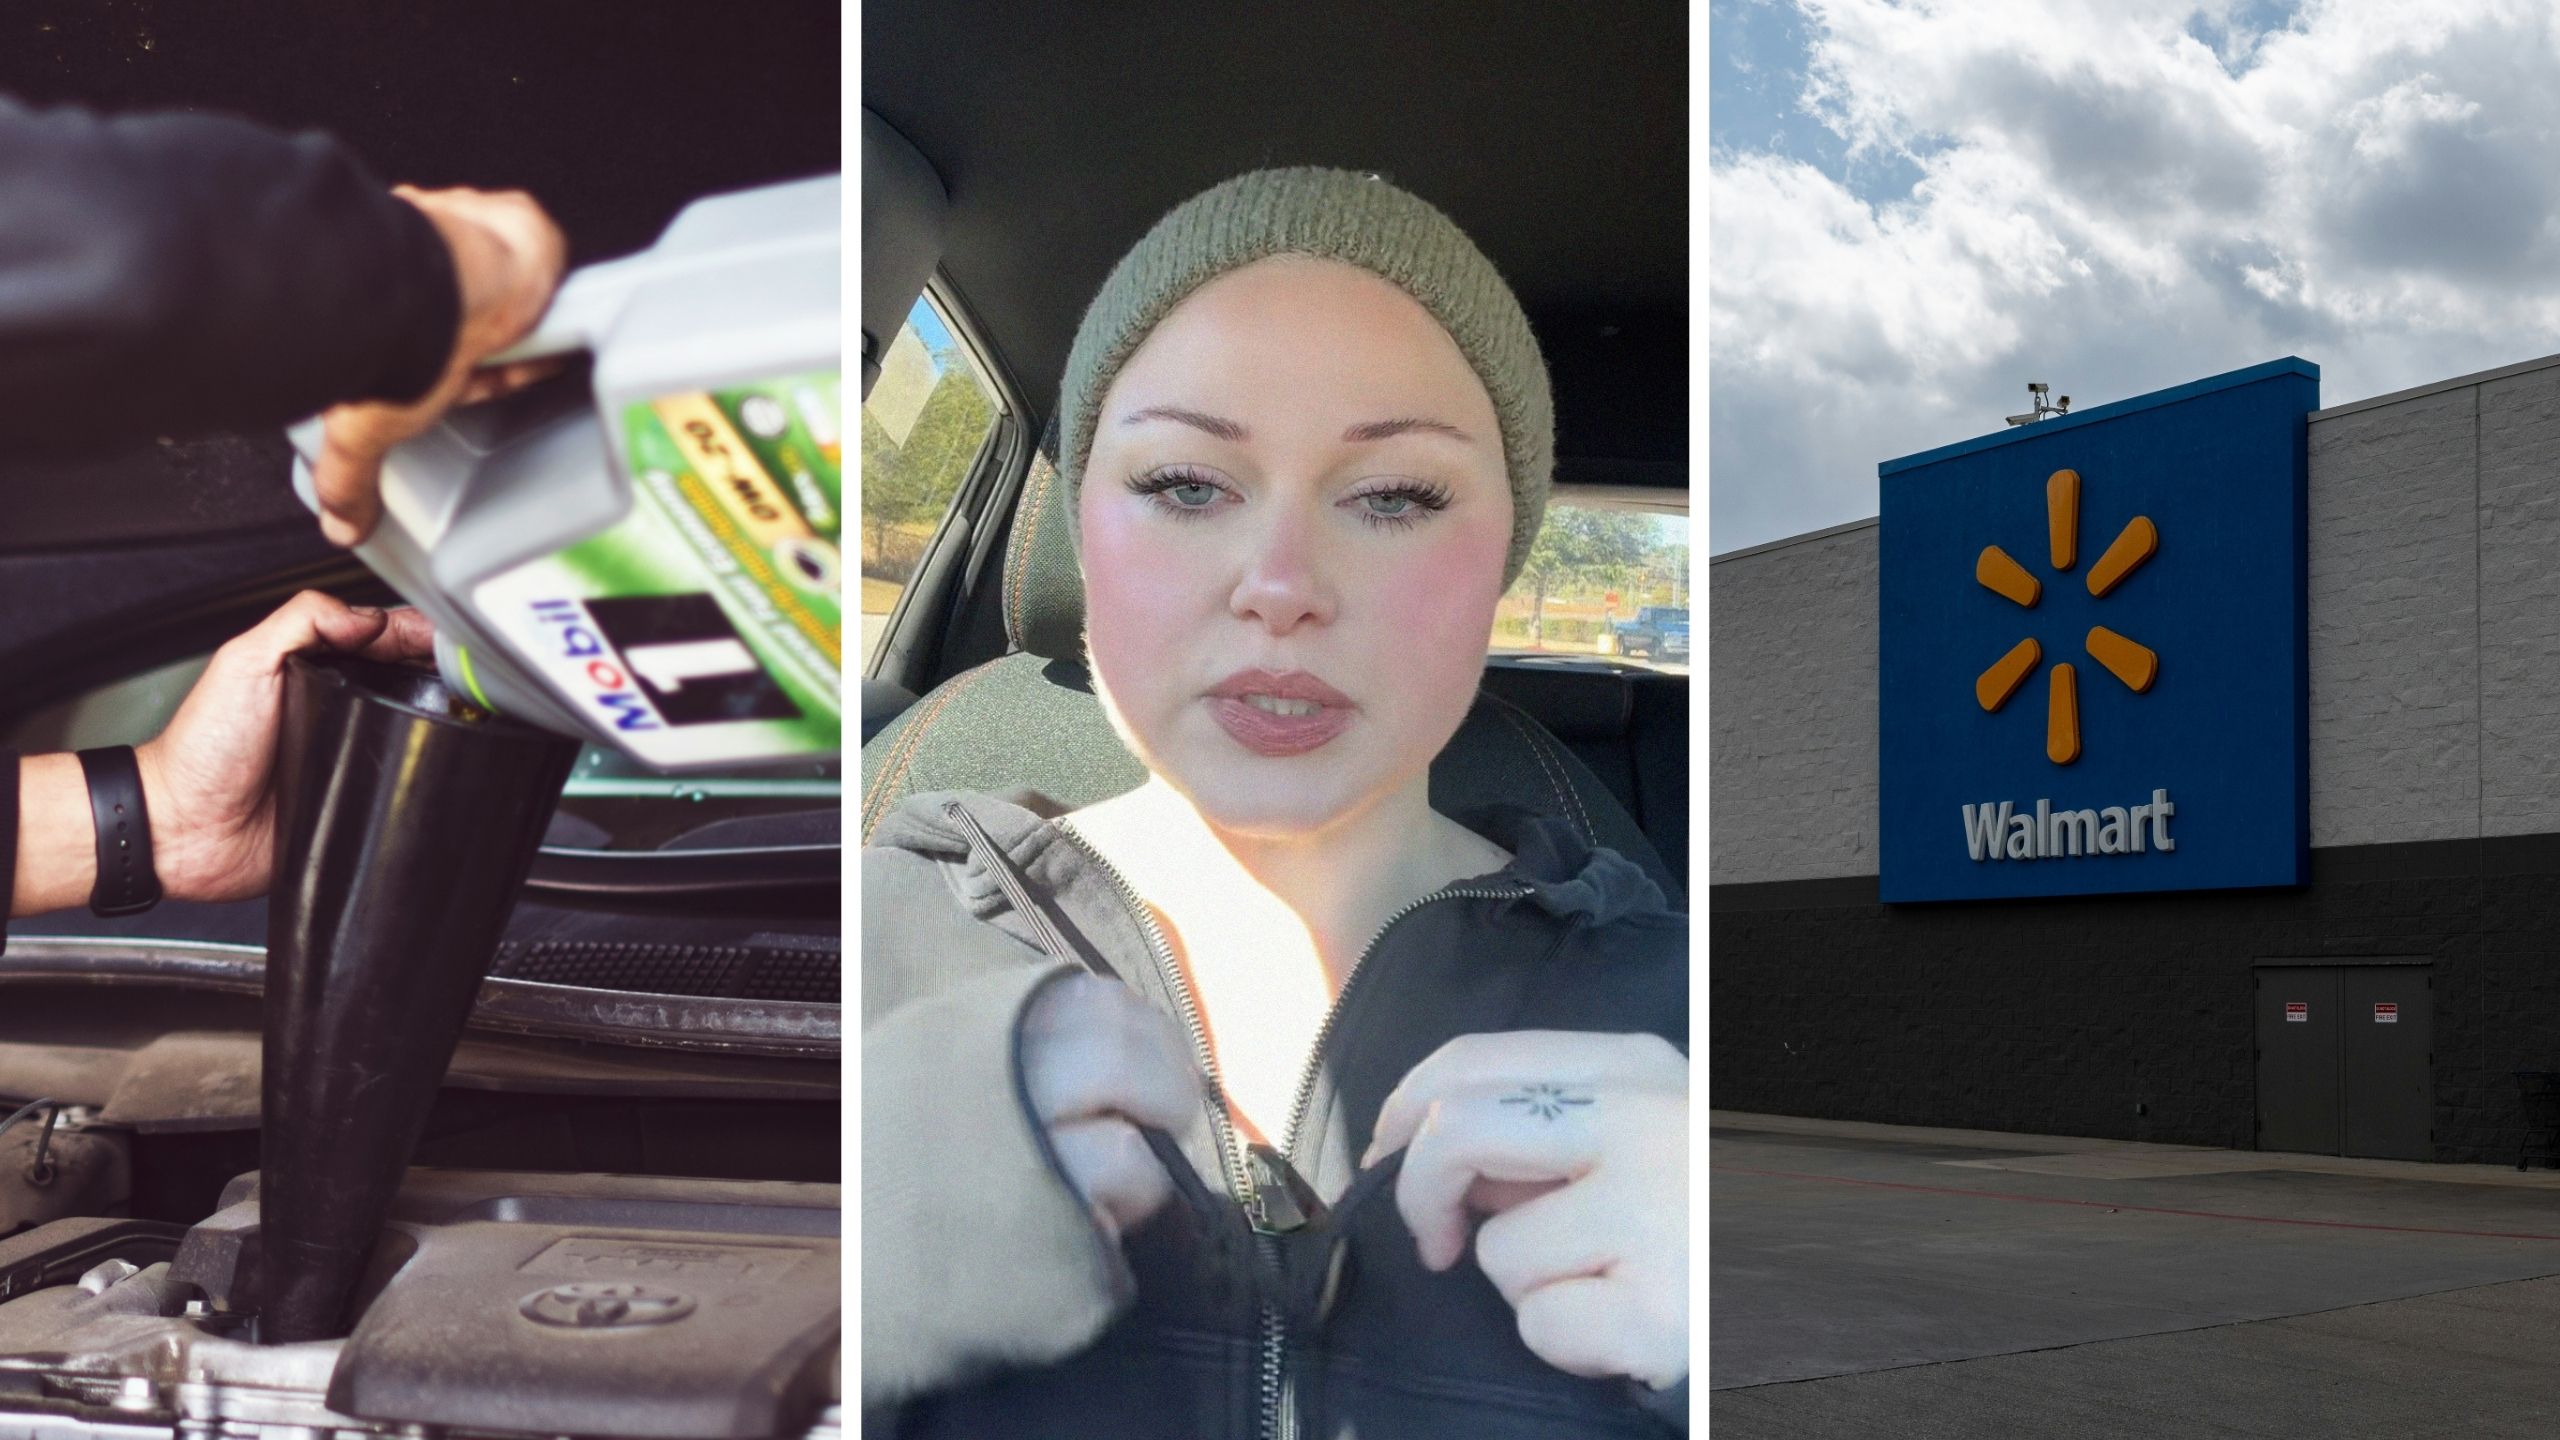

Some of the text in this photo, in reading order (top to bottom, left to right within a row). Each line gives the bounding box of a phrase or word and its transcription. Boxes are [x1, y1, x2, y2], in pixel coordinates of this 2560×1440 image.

[684, 419, 780, 522] 0W-20
[528, 599, 660, 732] Mobil
[623, 637, 760, 694] 1
[1961, 788, 2176, 862] Walmart
